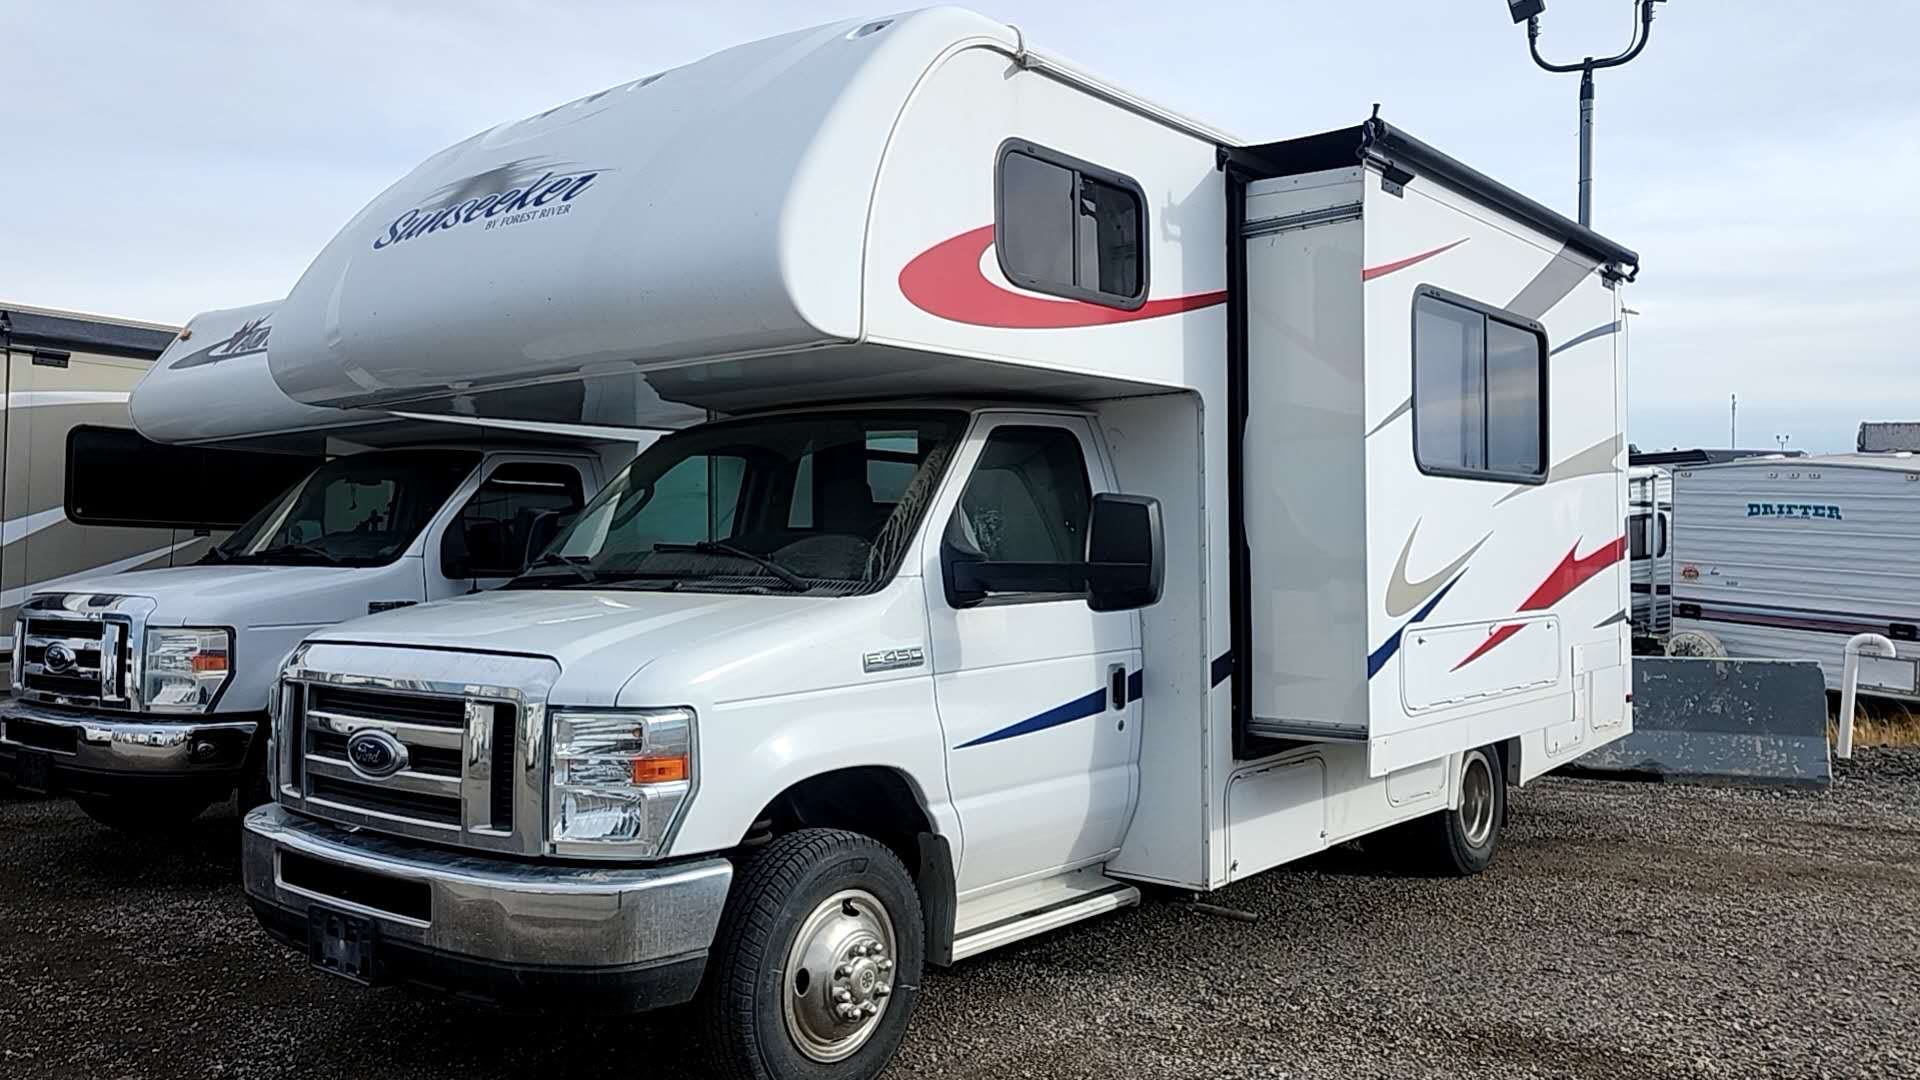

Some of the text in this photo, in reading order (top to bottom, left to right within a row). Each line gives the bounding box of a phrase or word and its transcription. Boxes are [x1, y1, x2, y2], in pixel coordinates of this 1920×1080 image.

[373, 172, 598, 249] Sunseeker
[484, 204, 572, 230] BY FOREST RIVER
[1747, 503, 1842, 520] DRIFTER
[356, 742, 381, 763] Ford
